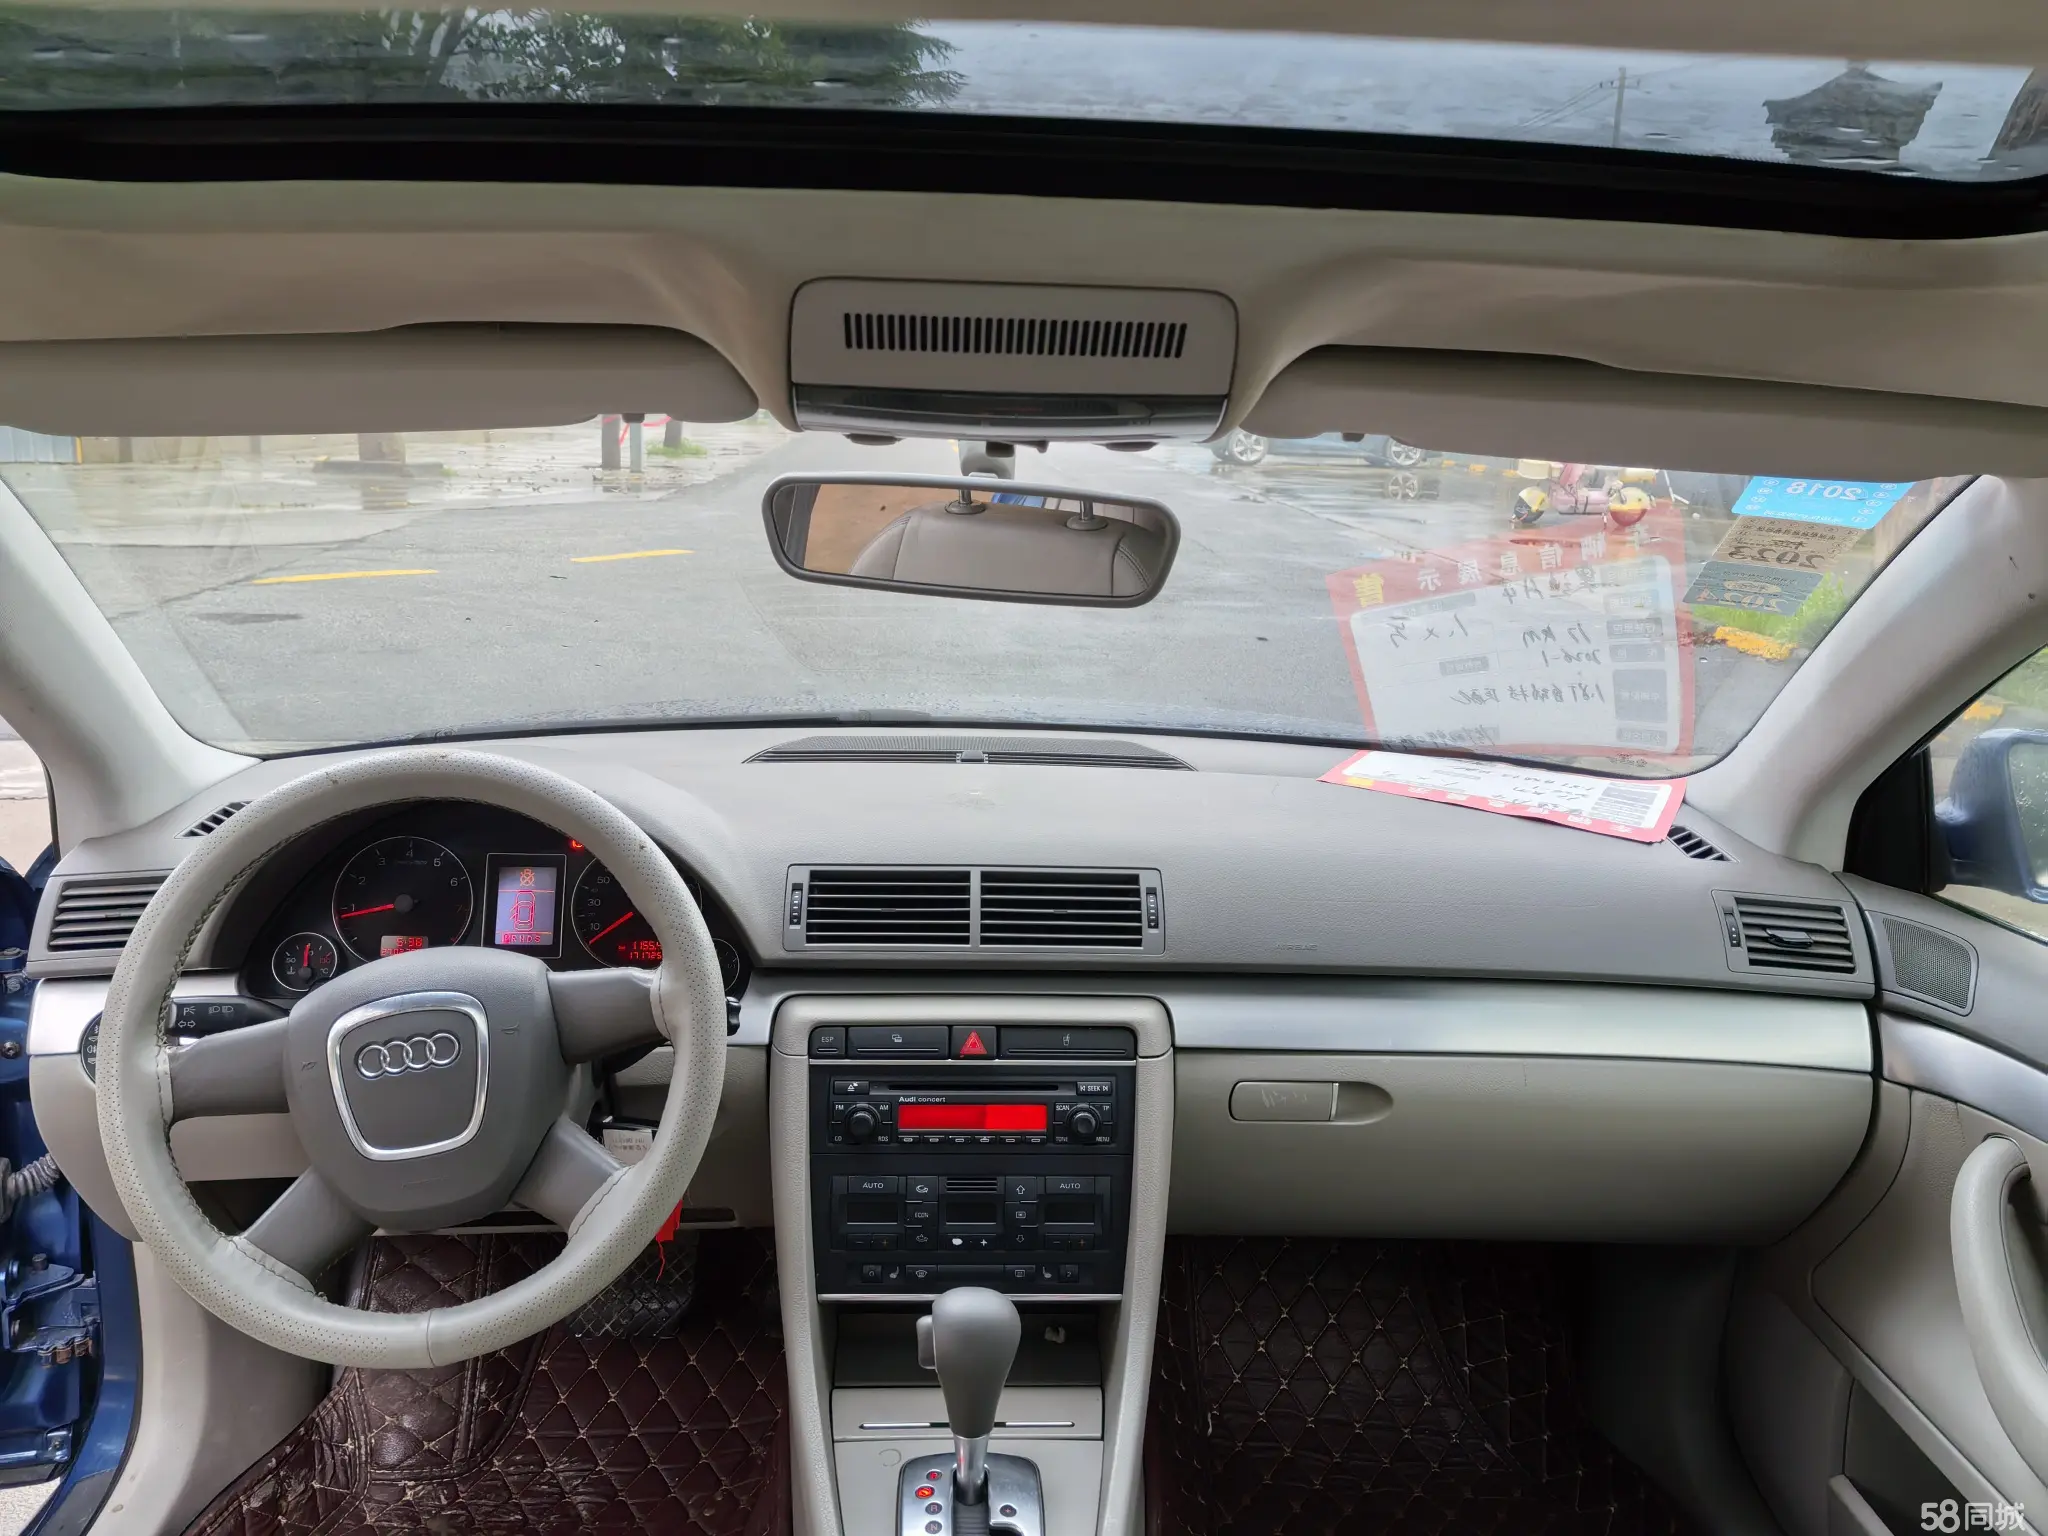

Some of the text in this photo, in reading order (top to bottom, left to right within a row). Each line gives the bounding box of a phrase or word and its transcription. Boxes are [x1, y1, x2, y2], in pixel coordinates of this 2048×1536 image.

[379, 857, 386, 866] 3
[358, 876, 366, 885] 2
[450, 878, 458, 887] 6
[597, 876, 610, 884] 50
[587, 898, 601, 907] 30
[590, 922, 600, 931] 10
[914, 1211, 930, 1219] ECON
